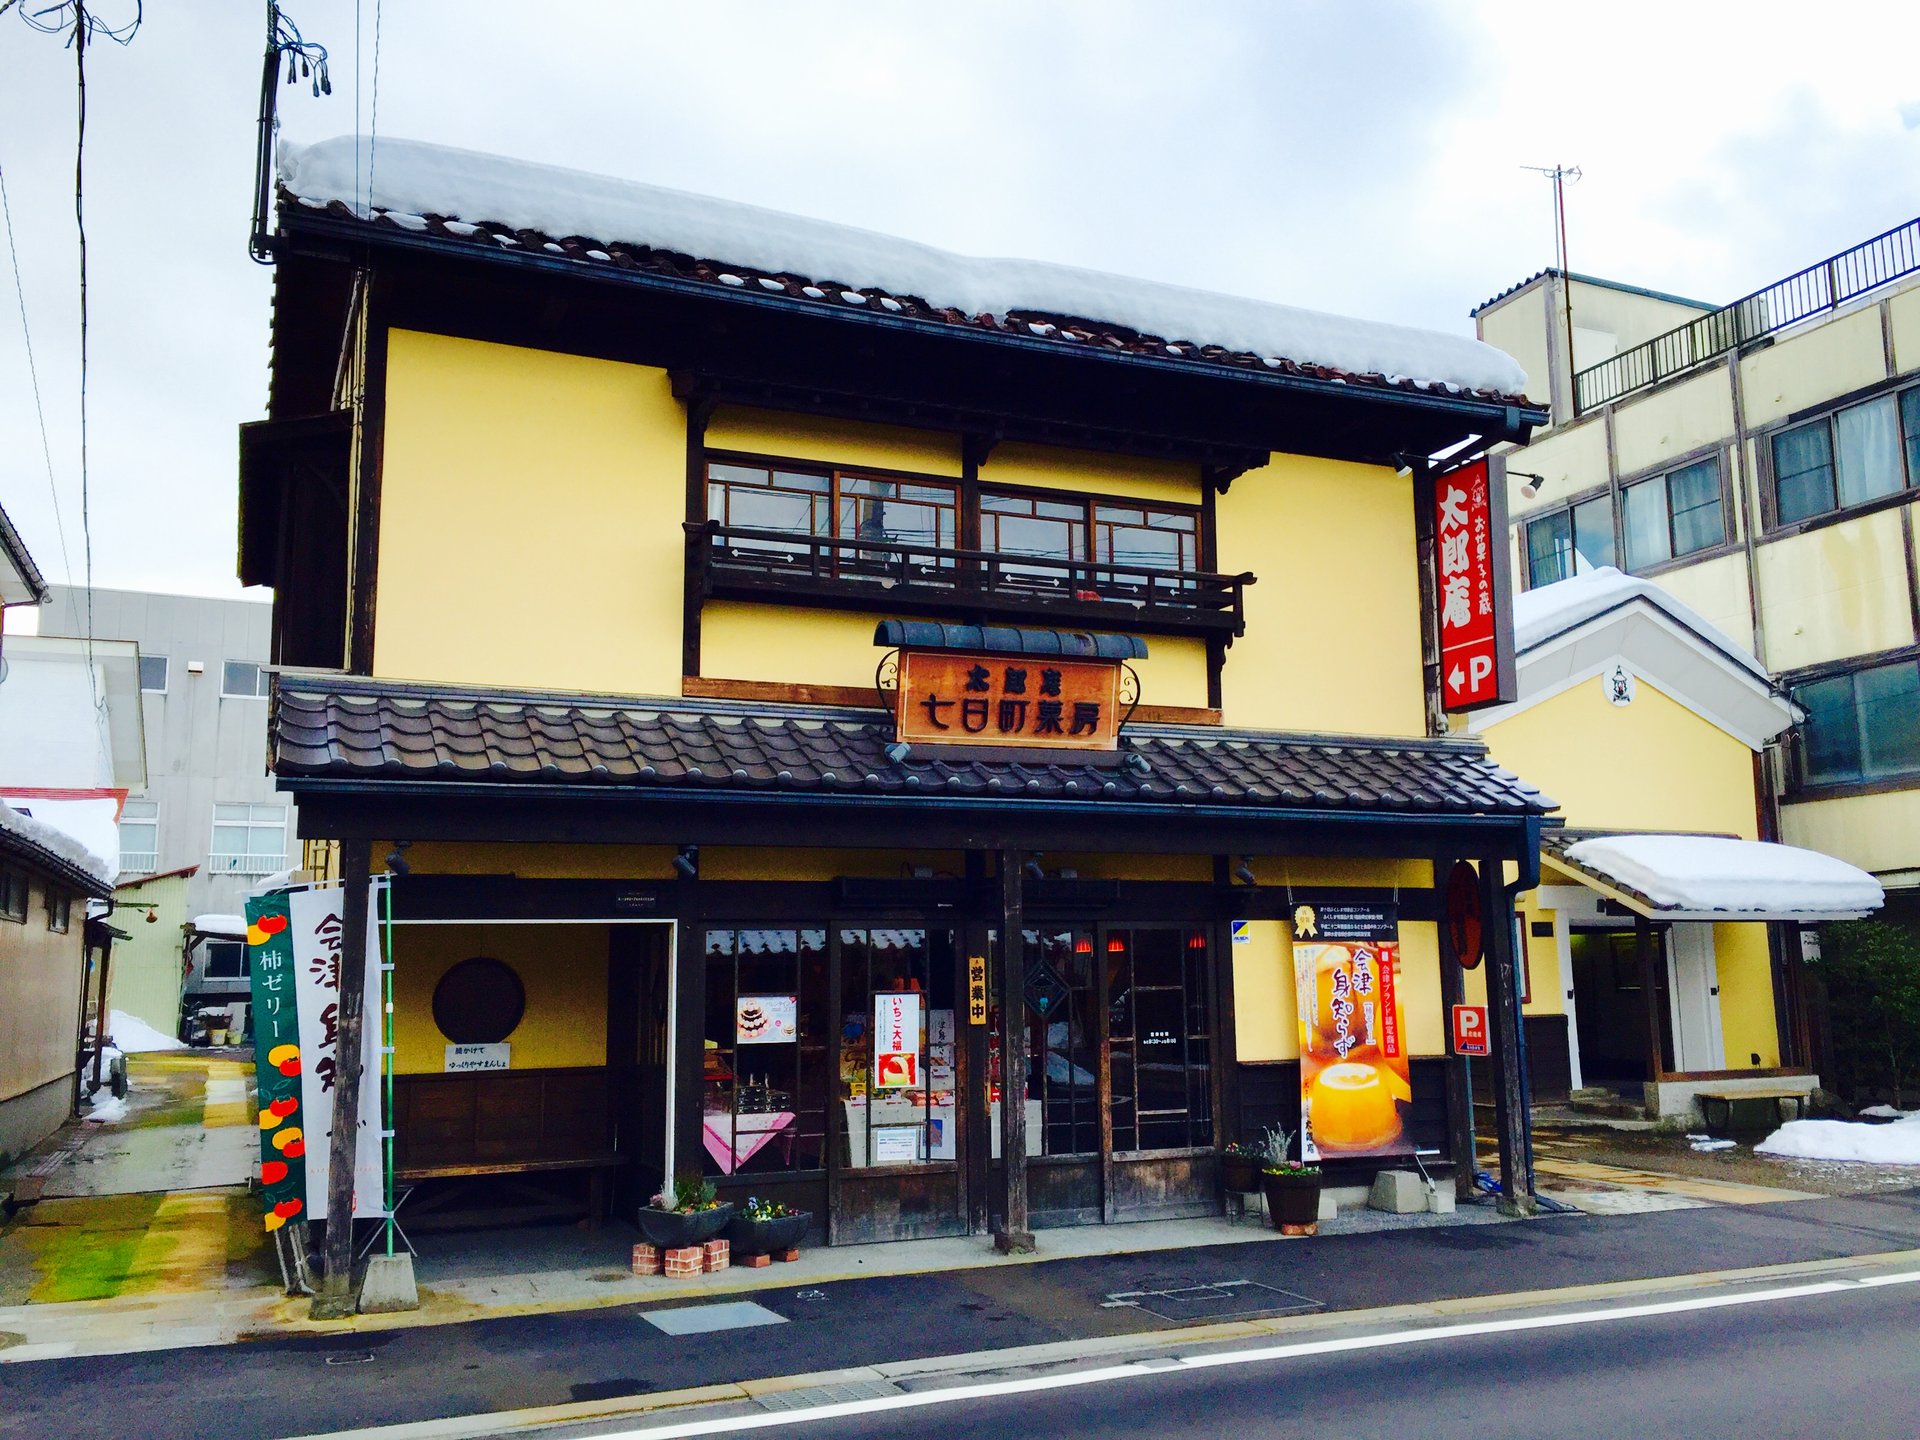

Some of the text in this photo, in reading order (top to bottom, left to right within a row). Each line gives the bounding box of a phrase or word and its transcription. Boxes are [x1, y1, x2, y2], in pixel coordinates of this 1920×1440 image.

[1439, 484, 1471, 629] 太郎庵
[1474, 516, 1493, 615] お菓子の蔵
[965, 663, 1062, 697] 太郎庵
[1470, 655, 1492, 693] P
[920, 693, 1101, 735] 七日町菓房
[259, 950, 283, 1038] 柿ゼリー
[971, 966, 984, 1019] 営業中
[1353, 949, 1373, 994] 会津
[892, 997, 902, 1051] いちご大福
[1459, 1010, 1479, 1037] P
